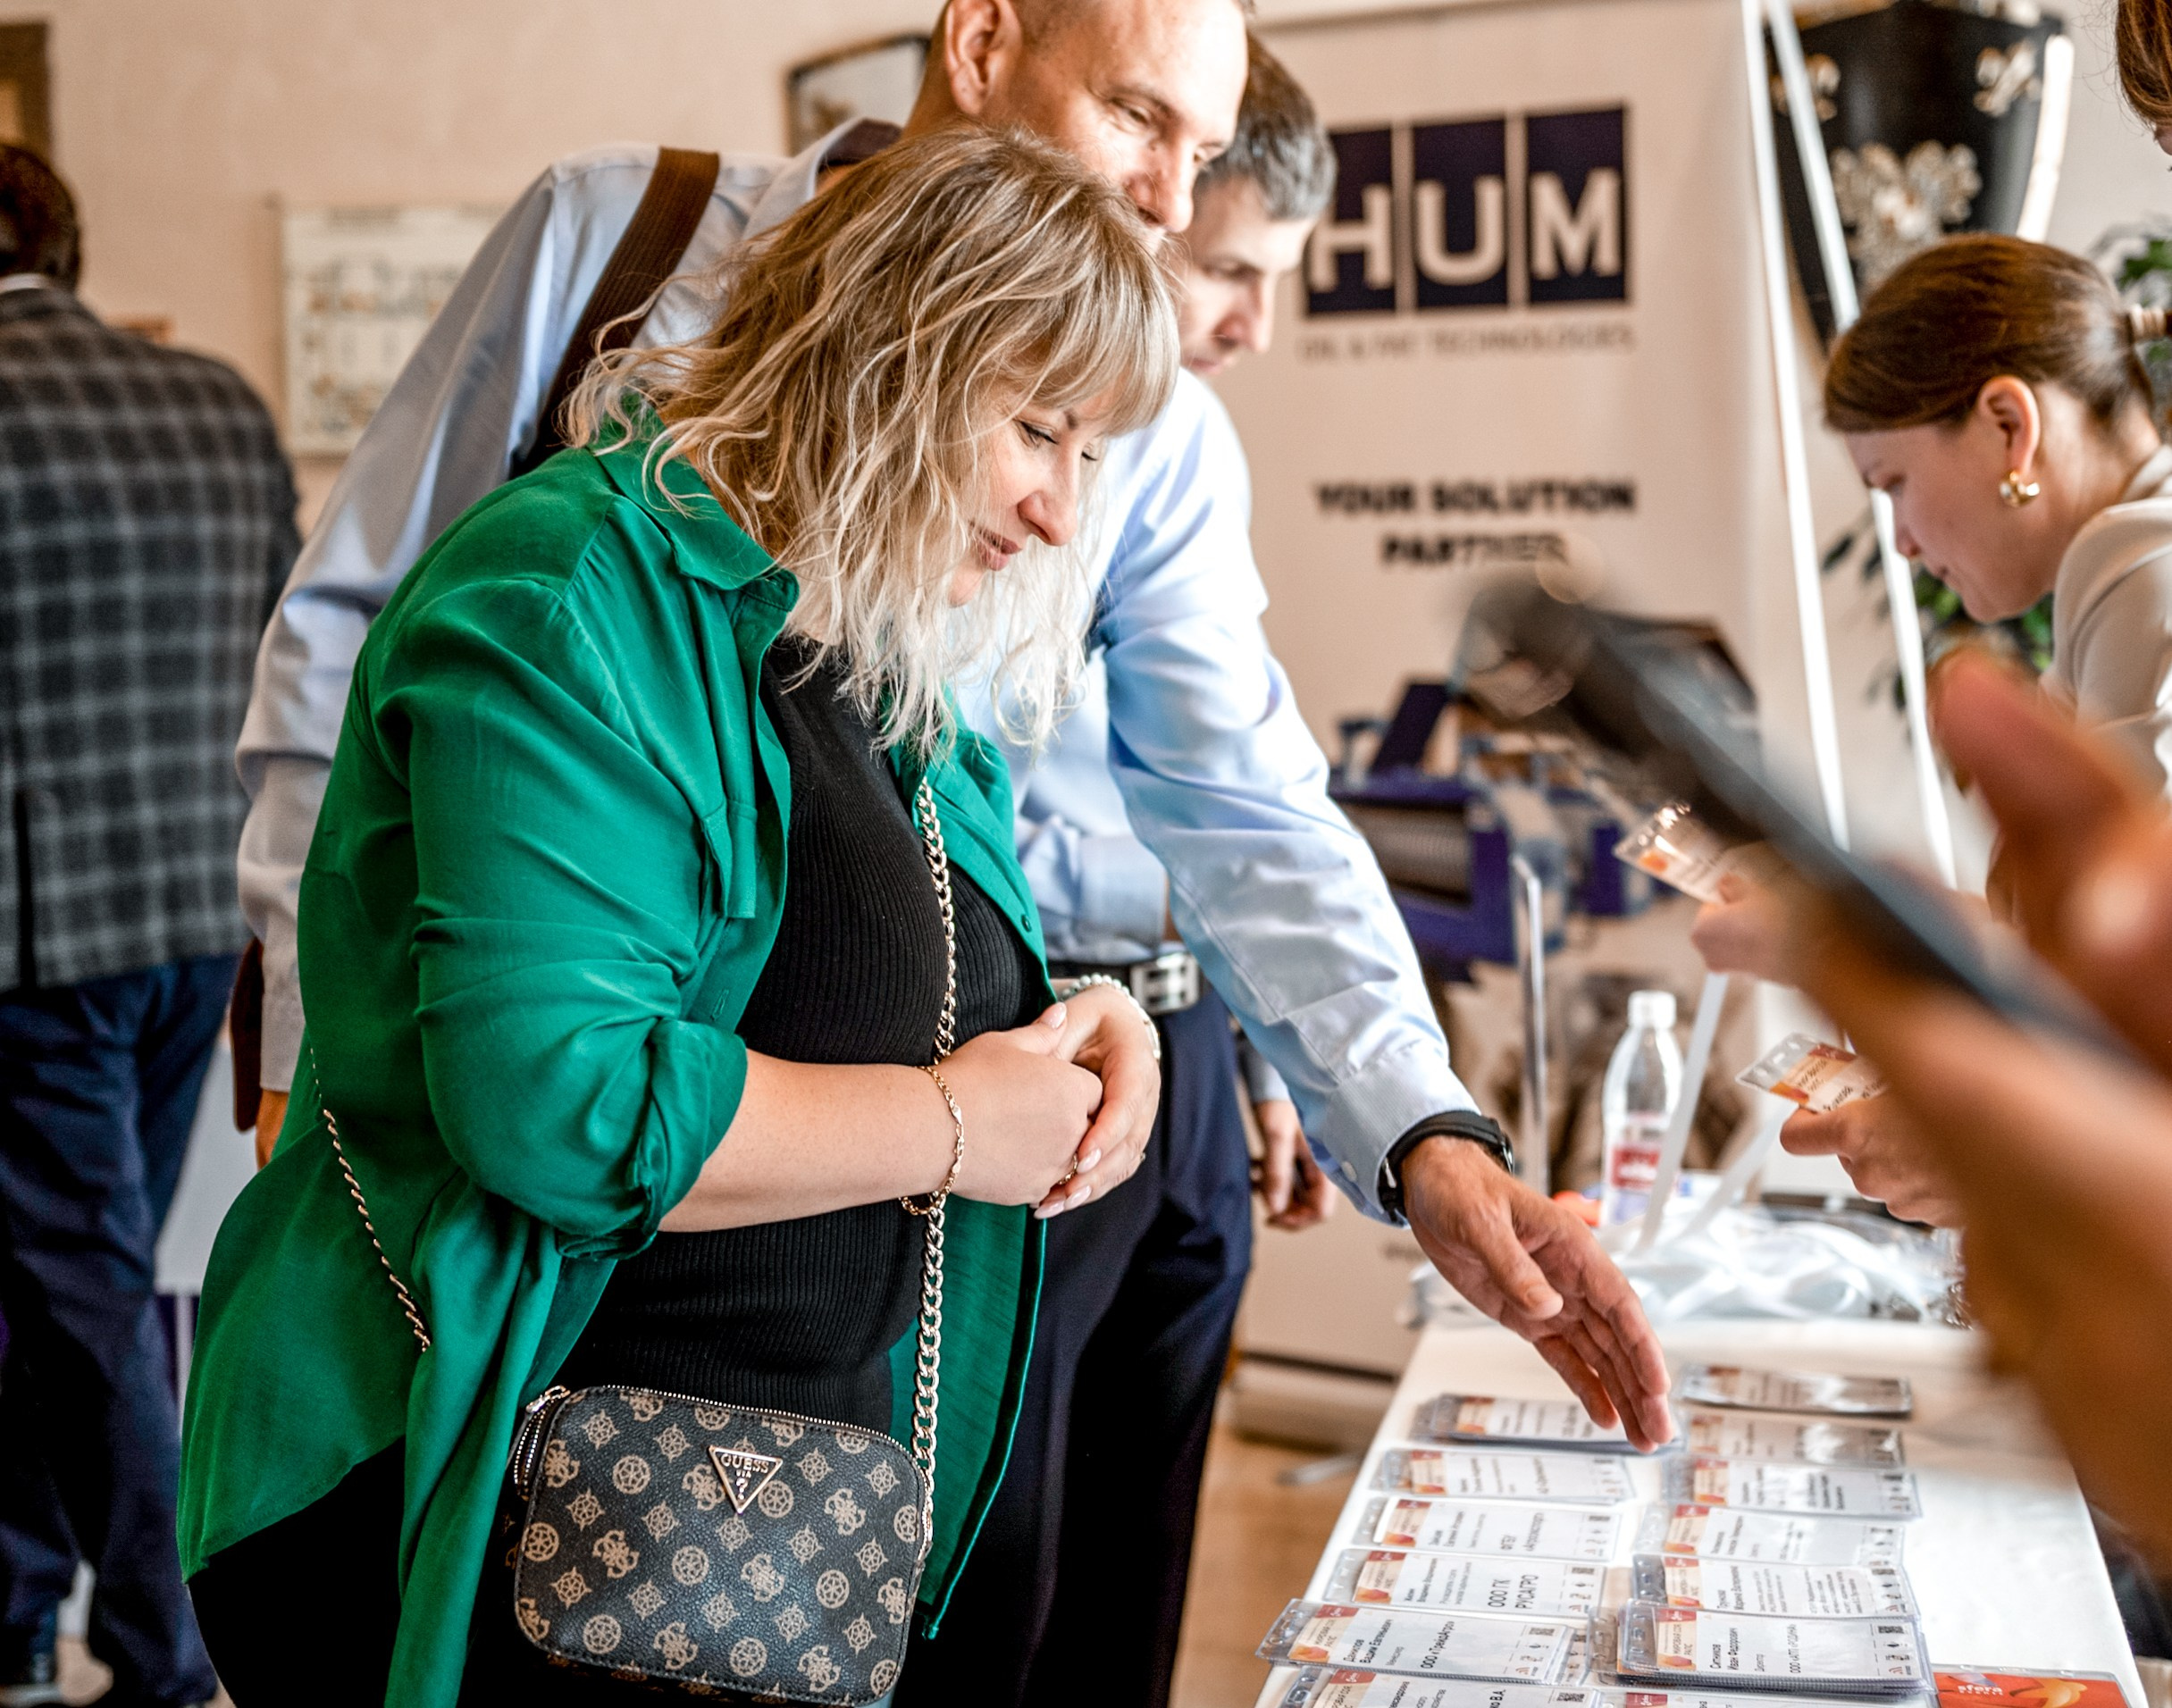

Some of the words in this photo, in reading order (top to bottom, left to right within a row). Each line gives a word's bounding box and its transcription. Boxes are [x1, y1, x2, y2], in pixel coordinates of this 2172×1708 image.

[1311, 168, 1621, 293] HUM
[1316, 481, 1417, 515] YOUR
[1430, 476, 1636, 514] SOLUTION
[720, 1453, 769, 1474] GUESS
[1488, 1589, 1507, 1608] ООО
[1515, 1574, 1539, 1609] РУСАГРО
[1344, 1638, 1364, 1663] Данилов
[1359, 1646, 1378, 1663] Вадим
[1421, 1655, 1438, 1669] ООО
[1727, 1656, 1739, 1670] Иван
[1958, 1684, 2003, 1693] sfera
